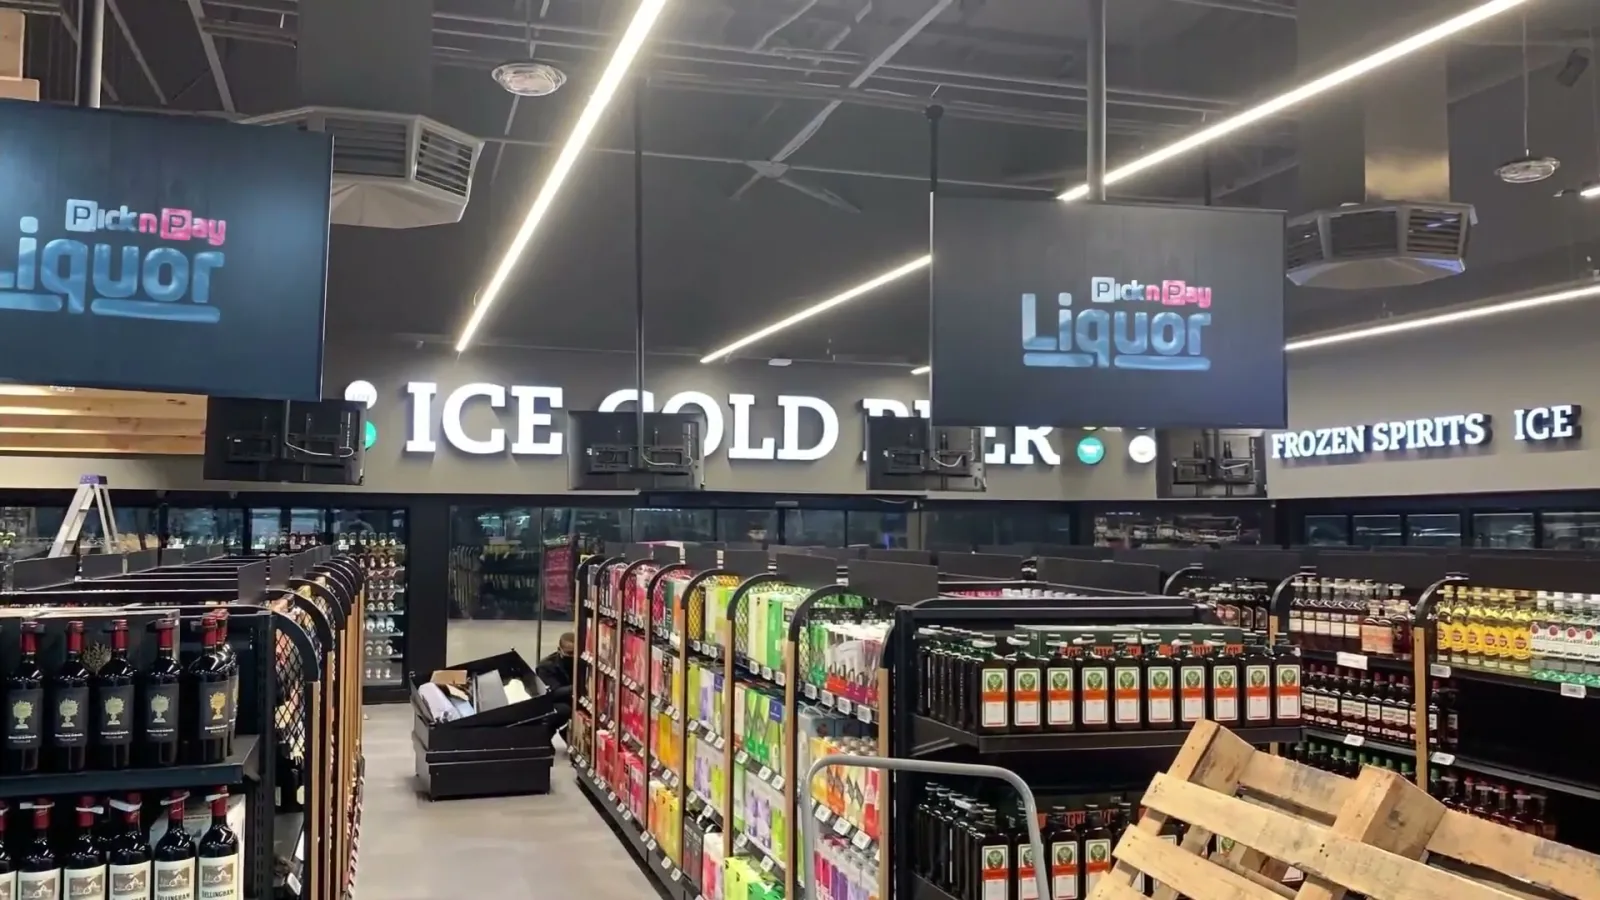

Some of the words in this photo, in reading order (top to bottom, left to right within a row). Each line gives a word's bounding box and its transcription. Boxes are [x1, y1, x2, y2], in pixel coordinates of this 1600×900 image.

[65, 199, 137, 233] Pick
[139, 213, 157, 233] n
[160, 207, 227, 246] Pay
[1092, 277, 1144, 302] Pick
[1145, 284, 1160, 301] n
[1162, 280, 1212, 308] Pay
[1022, 292, 1212, 368] Liquor
[406, 382, 563, 455] ICE
[1271, 425, 1365, 459] FROZEN
[1372, 413, 1486, 451] SPIRITS
[1514, 405, 1573, 441] ICE
